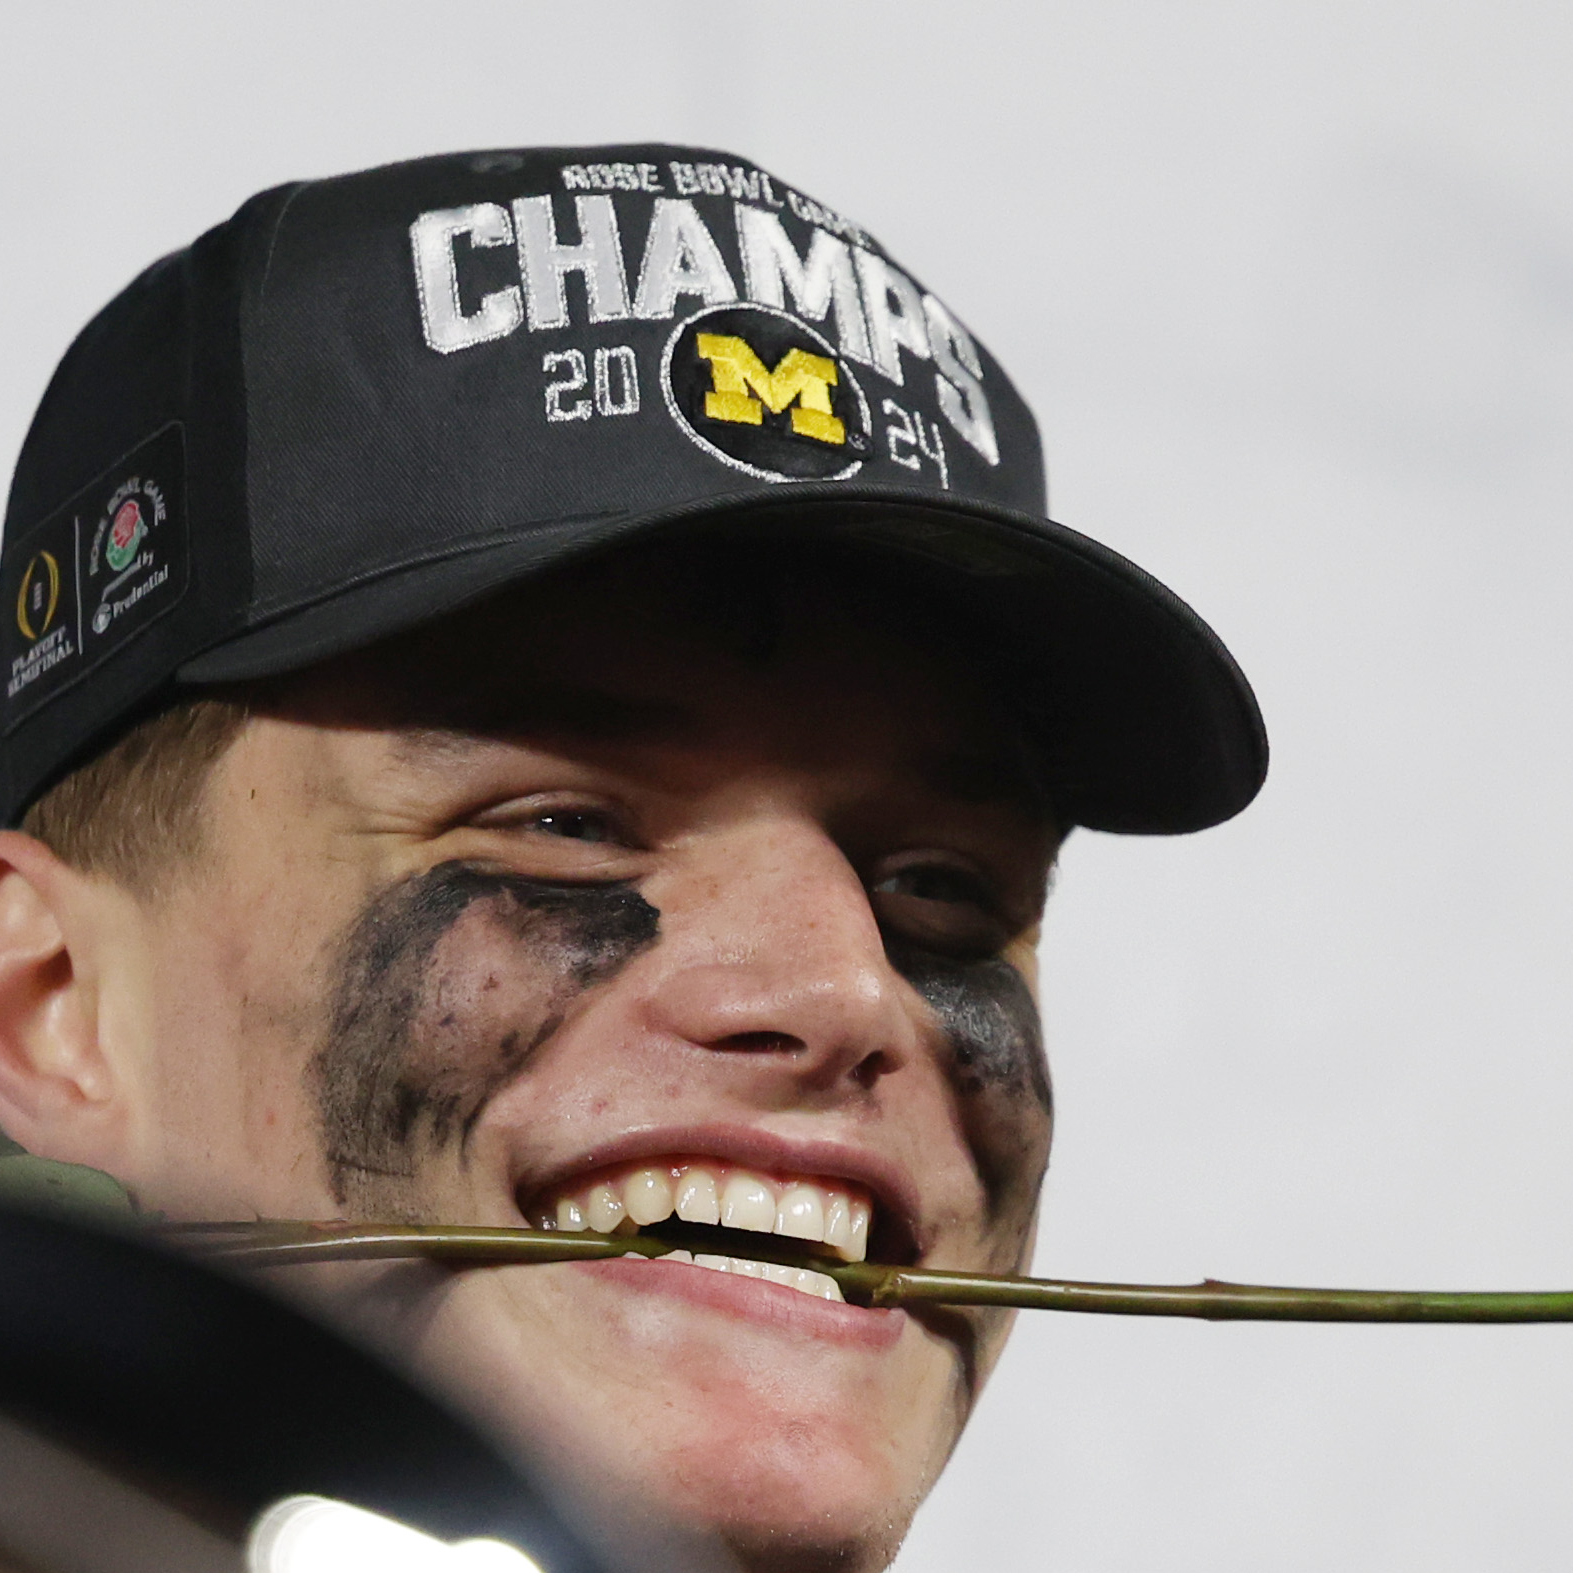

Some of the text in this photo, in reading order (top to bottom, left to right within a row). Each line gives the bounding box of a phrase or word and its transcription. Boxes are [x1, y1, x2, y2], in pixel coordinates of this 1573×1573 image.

[561, 163, 664, 192] ROSE
[670, 161, 784, 208] BOWL
[409, 194, 1000, 467] CHAMPS
[543, 346, 948, 488] 20 24
[696, 332, 845, 446] M
[144, 479, 166, 526] GAME
[113, 564, 169, 617] Prudential
